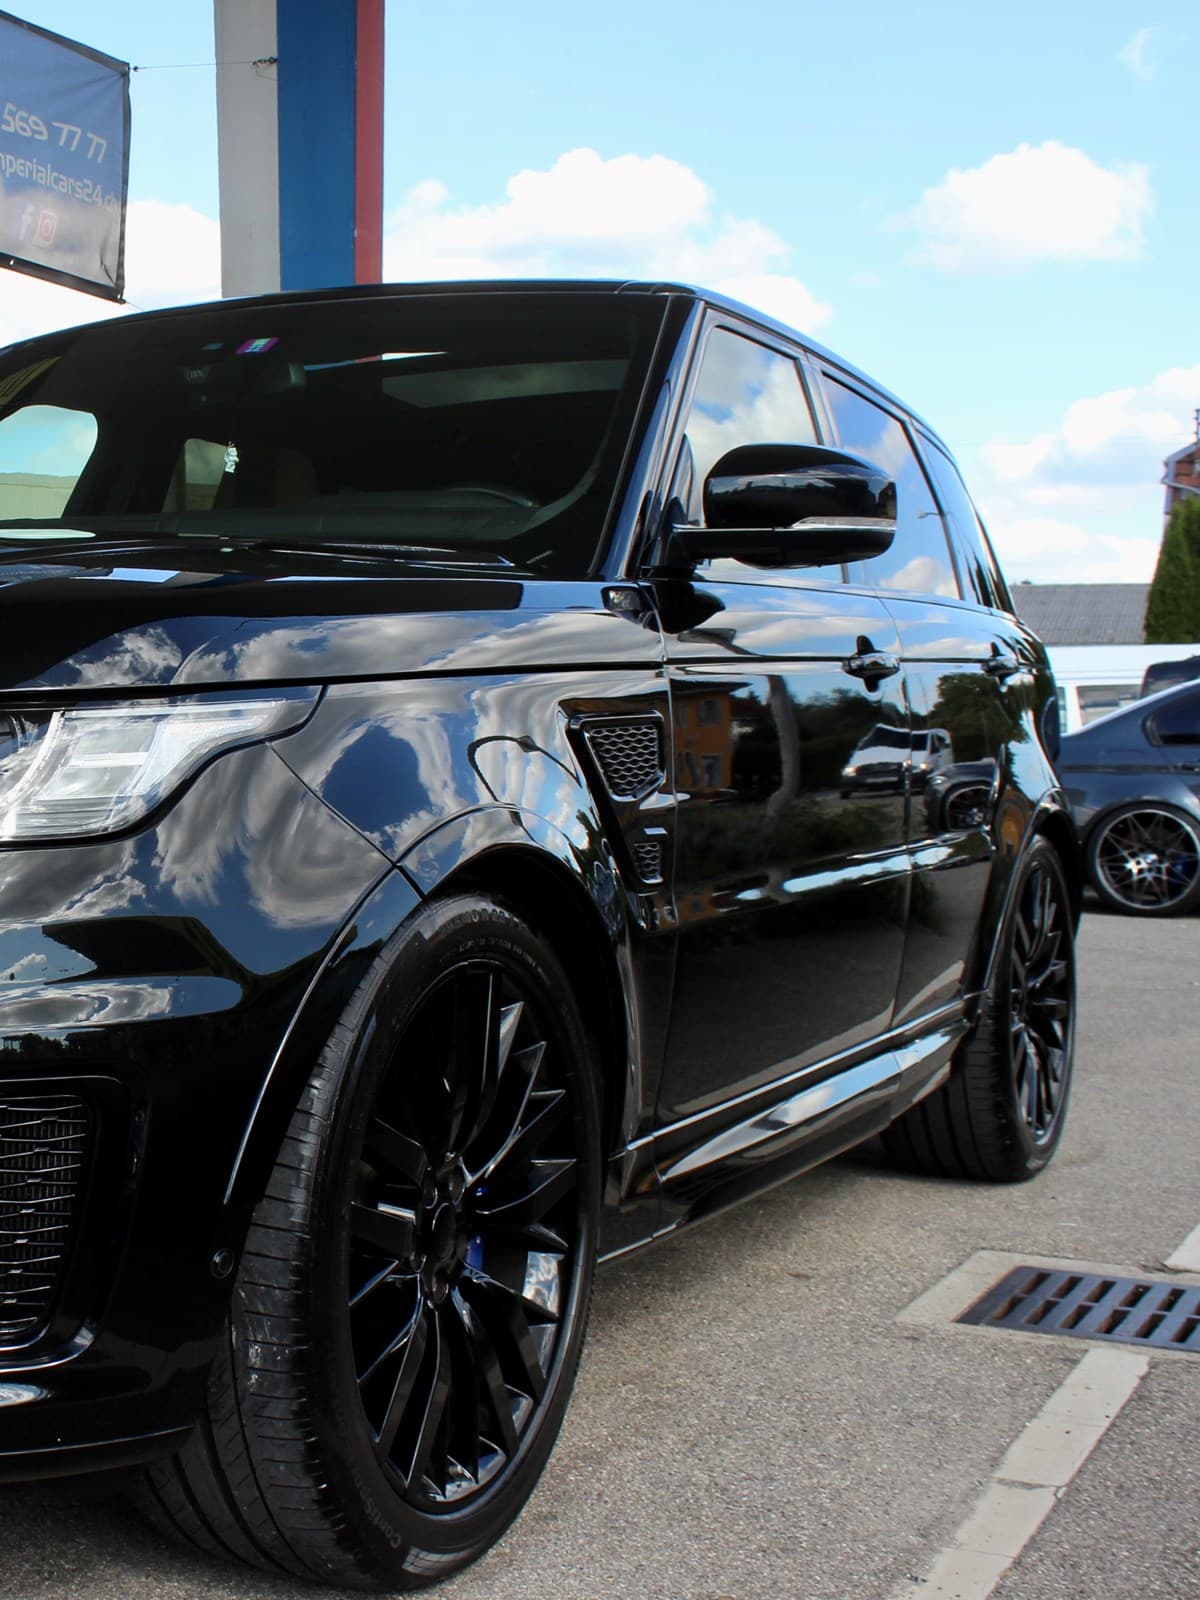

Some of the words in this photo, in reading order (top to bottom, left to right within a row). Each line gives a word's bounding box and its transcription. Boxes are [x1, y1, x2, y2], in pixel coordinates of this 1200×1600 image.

[2, 103, 49, 141] 569
[52, 121, 82, 151] 77
[87, 131, 108, 164] 77
